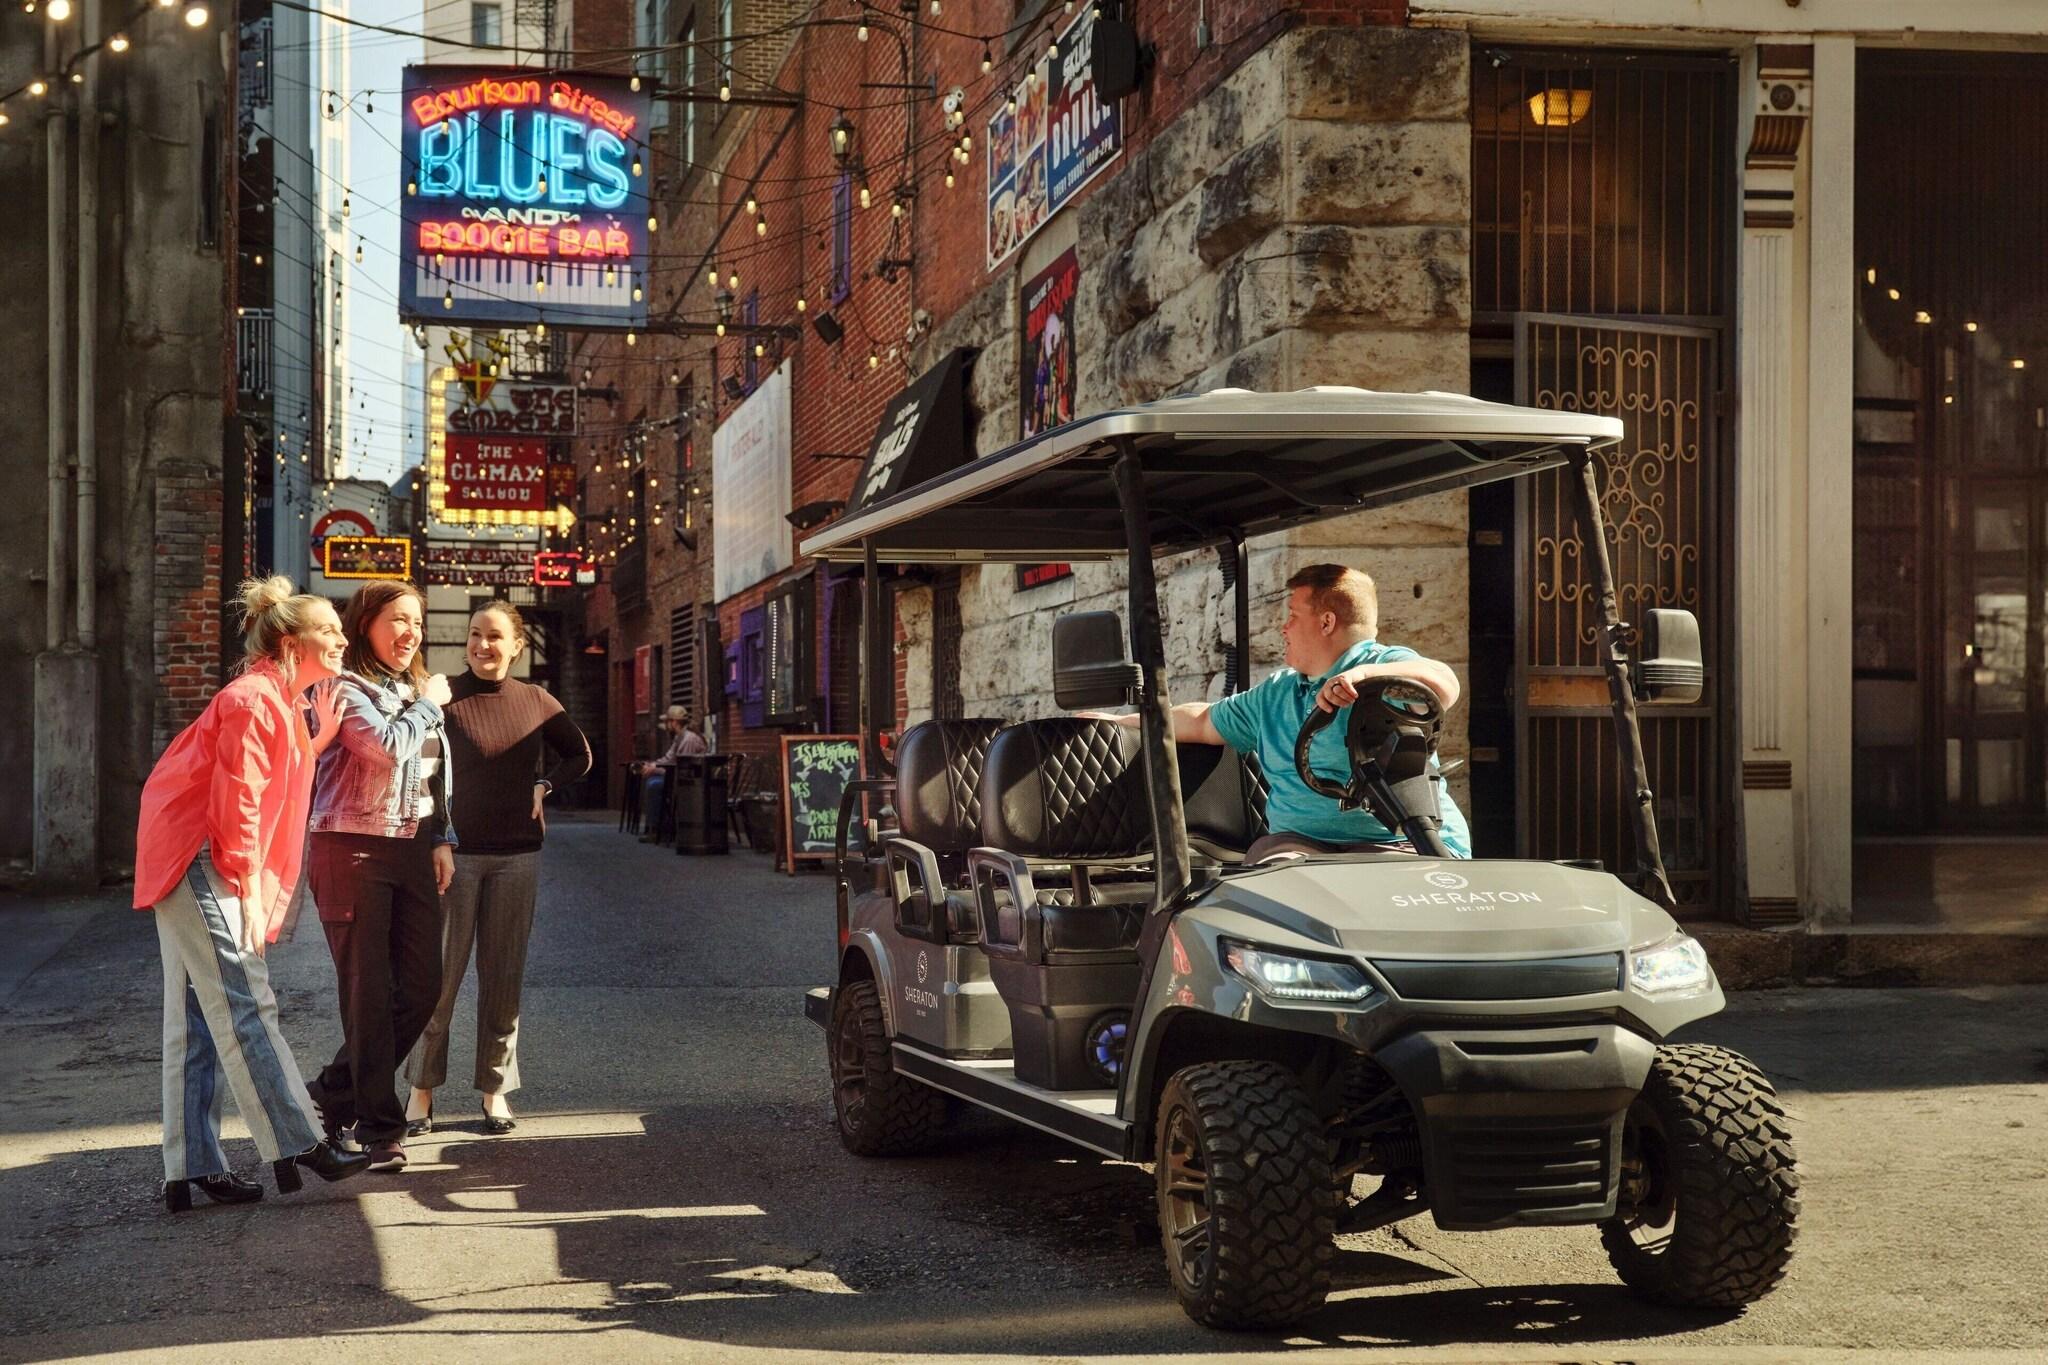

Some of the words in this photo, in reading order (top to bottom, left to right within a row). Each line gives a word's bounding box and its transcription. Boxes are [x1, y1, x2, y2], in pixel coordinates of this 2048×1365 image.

[412, 78, 541, 126] Bourbon
[549, 81, 636, 139] Street
[1052, 83, 1111, 170] BRUNC
[419, 109, 630, 209] BLUES
[479, 207, 560, 226] AND
[419, 221, 550, 254] BOOGIE
[558, 228, 630, 256] BAR
[482, 445, 513, 460] THE
[450, 462, 541, 483] CLIMAX
[462, 486, 531, 501] SALOON
[1391, 891, 1542, 907] SHERATON
[905, 986, 938, 1009] SHERATON
